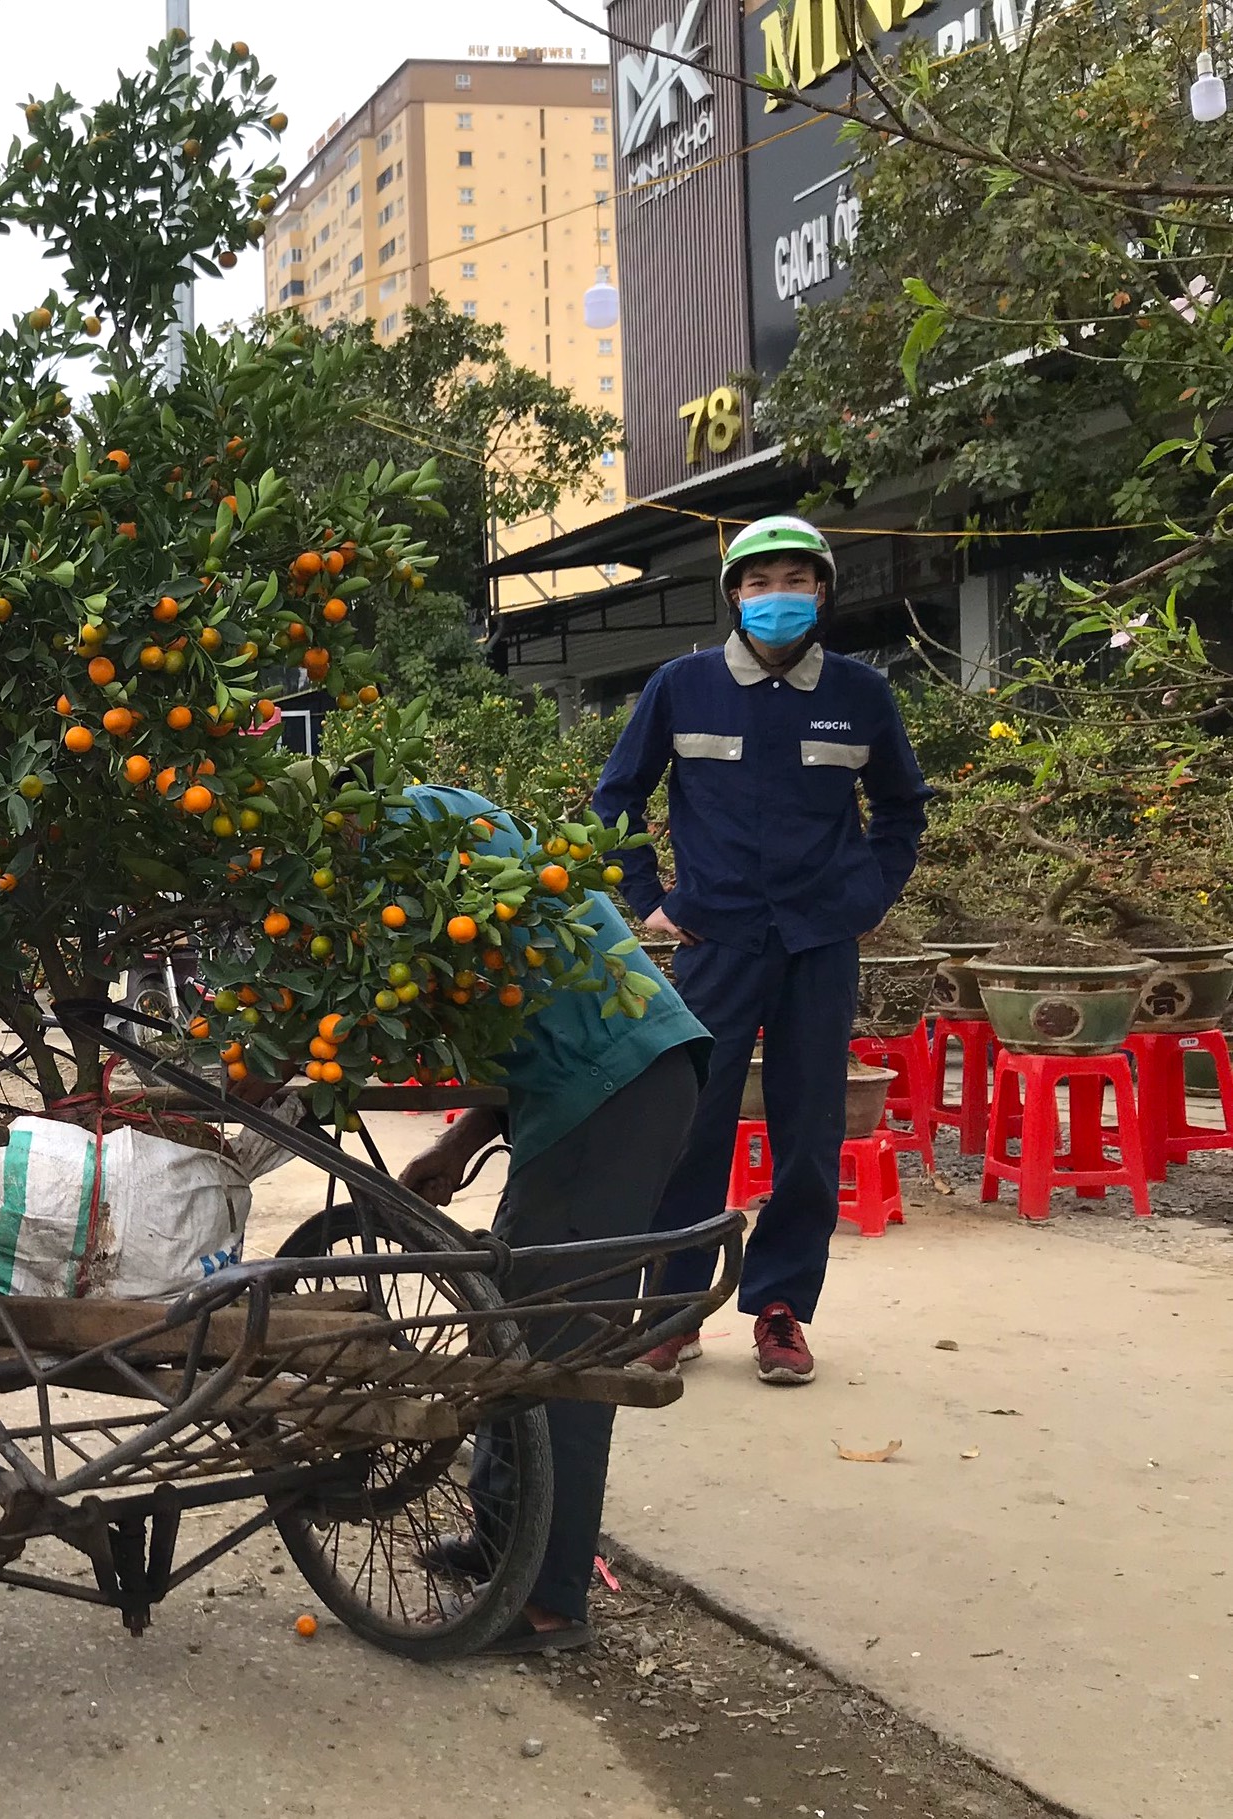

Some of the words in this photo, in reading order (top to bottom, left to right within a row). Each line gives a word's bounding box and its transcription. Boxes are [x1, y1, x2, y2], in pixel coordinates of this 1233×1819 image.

[673, 110, 714, 164] KHÔI
[774, 214, 830, 309] GẠCH
[679, 386, 737, 464] 78
